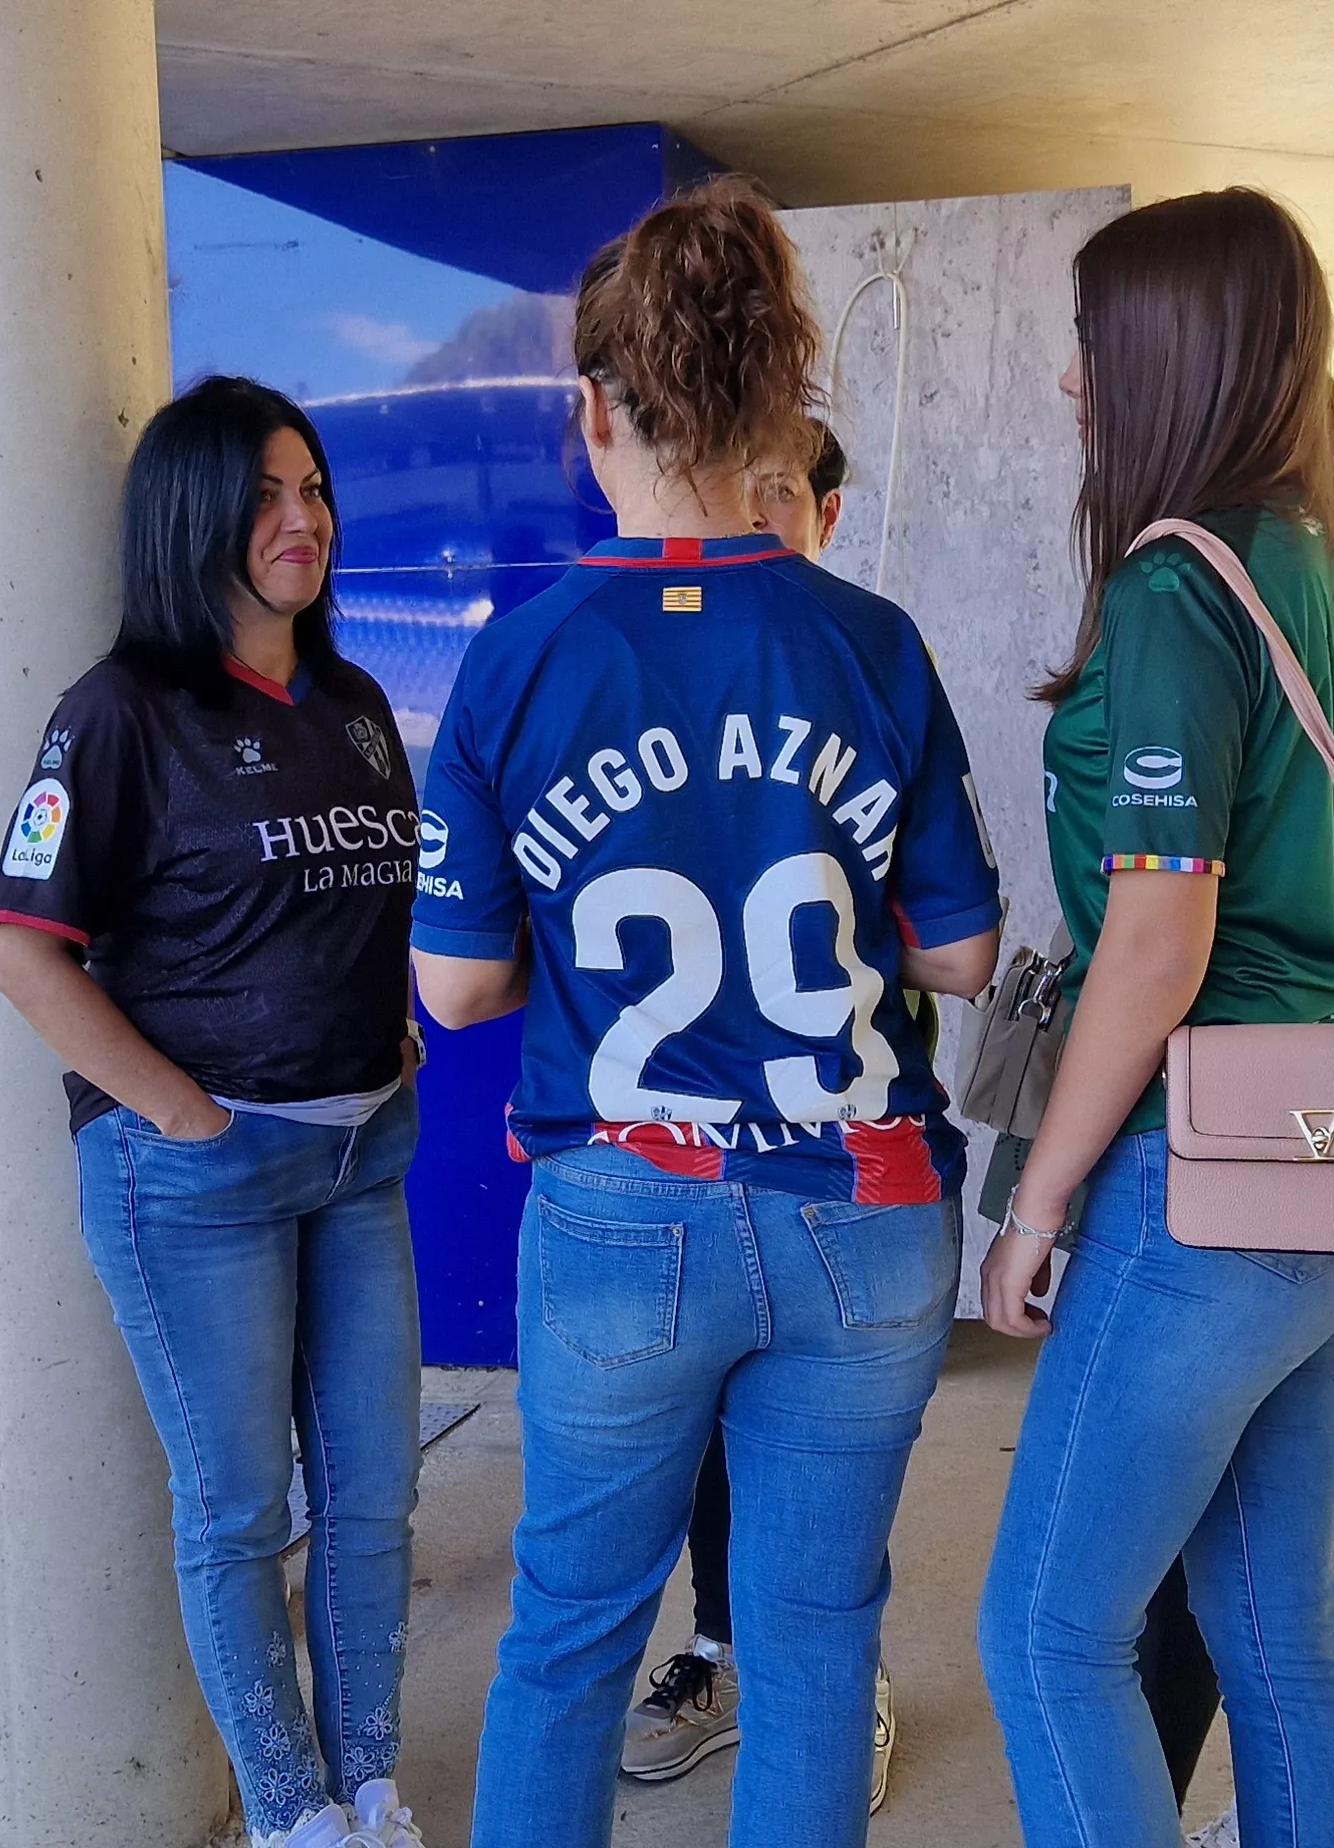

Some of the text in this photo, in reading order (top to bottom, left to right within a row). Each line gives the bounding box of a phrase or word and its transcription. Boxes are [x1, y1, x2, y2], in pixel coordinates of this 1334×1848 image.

[512, 726, 689, 890] DIEGO
[1112, 793, 1198, 808] COSEHISA
[415, 871, 464, 900] EHISA
[572, 852, 900, 1122] 29
